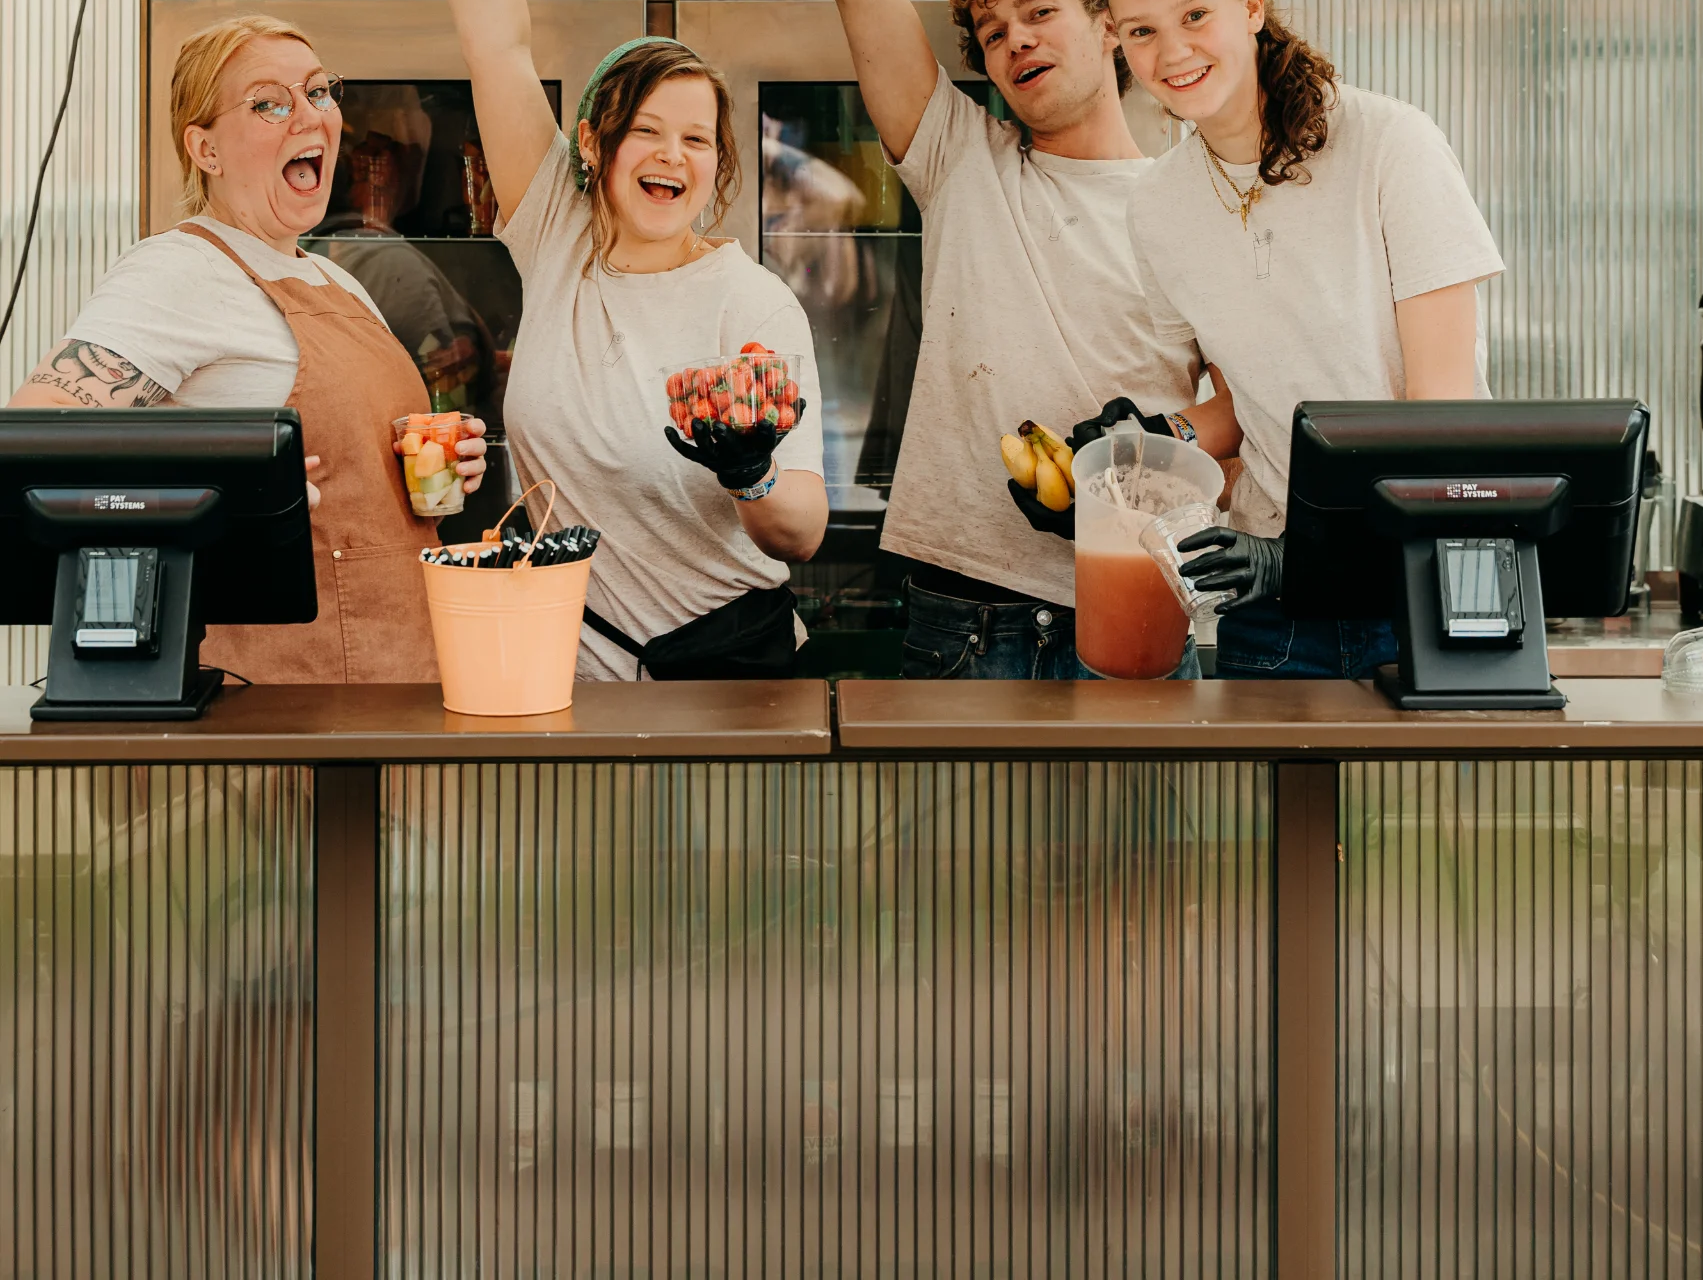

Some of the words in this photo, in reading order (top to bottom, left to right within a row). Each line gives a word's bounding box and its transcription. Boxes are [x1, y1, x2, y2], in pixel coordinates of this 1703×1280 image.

[1461, 483, 1478, 491] PAY
[1462, 490, 1498, 498] SYSTEMS
[109, 502, 145, 510] SYSTEMS
